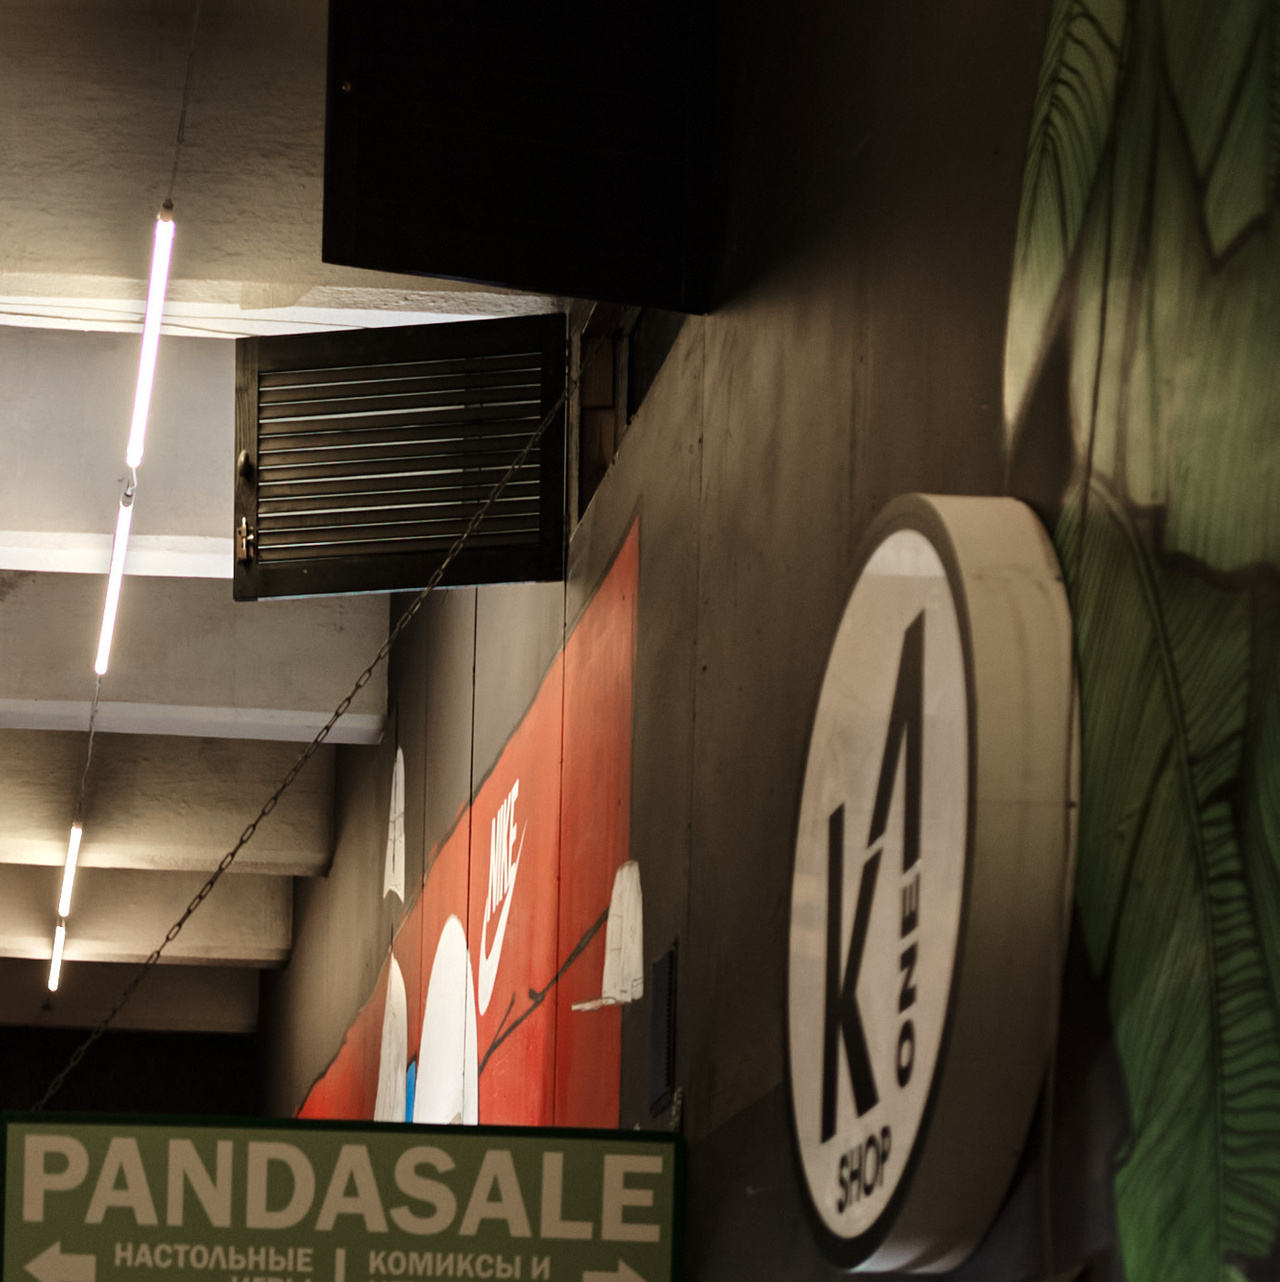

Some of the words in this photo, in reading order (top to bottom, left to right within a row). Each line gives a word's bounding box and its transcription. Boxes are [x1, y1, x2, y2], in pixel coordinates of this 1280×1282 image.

[487, 778, 519, 923] NIKE
[22, 1133, 663, 1242] PANDASALE
[836, 1144, 892, 1214] SHOP
[114, 1241, 314, 1273] НАСТОЛЬНЫЕ
[369, 1249, 521, 1280] КОМИКСЫ
[531, 1255, 551, 1281] И
